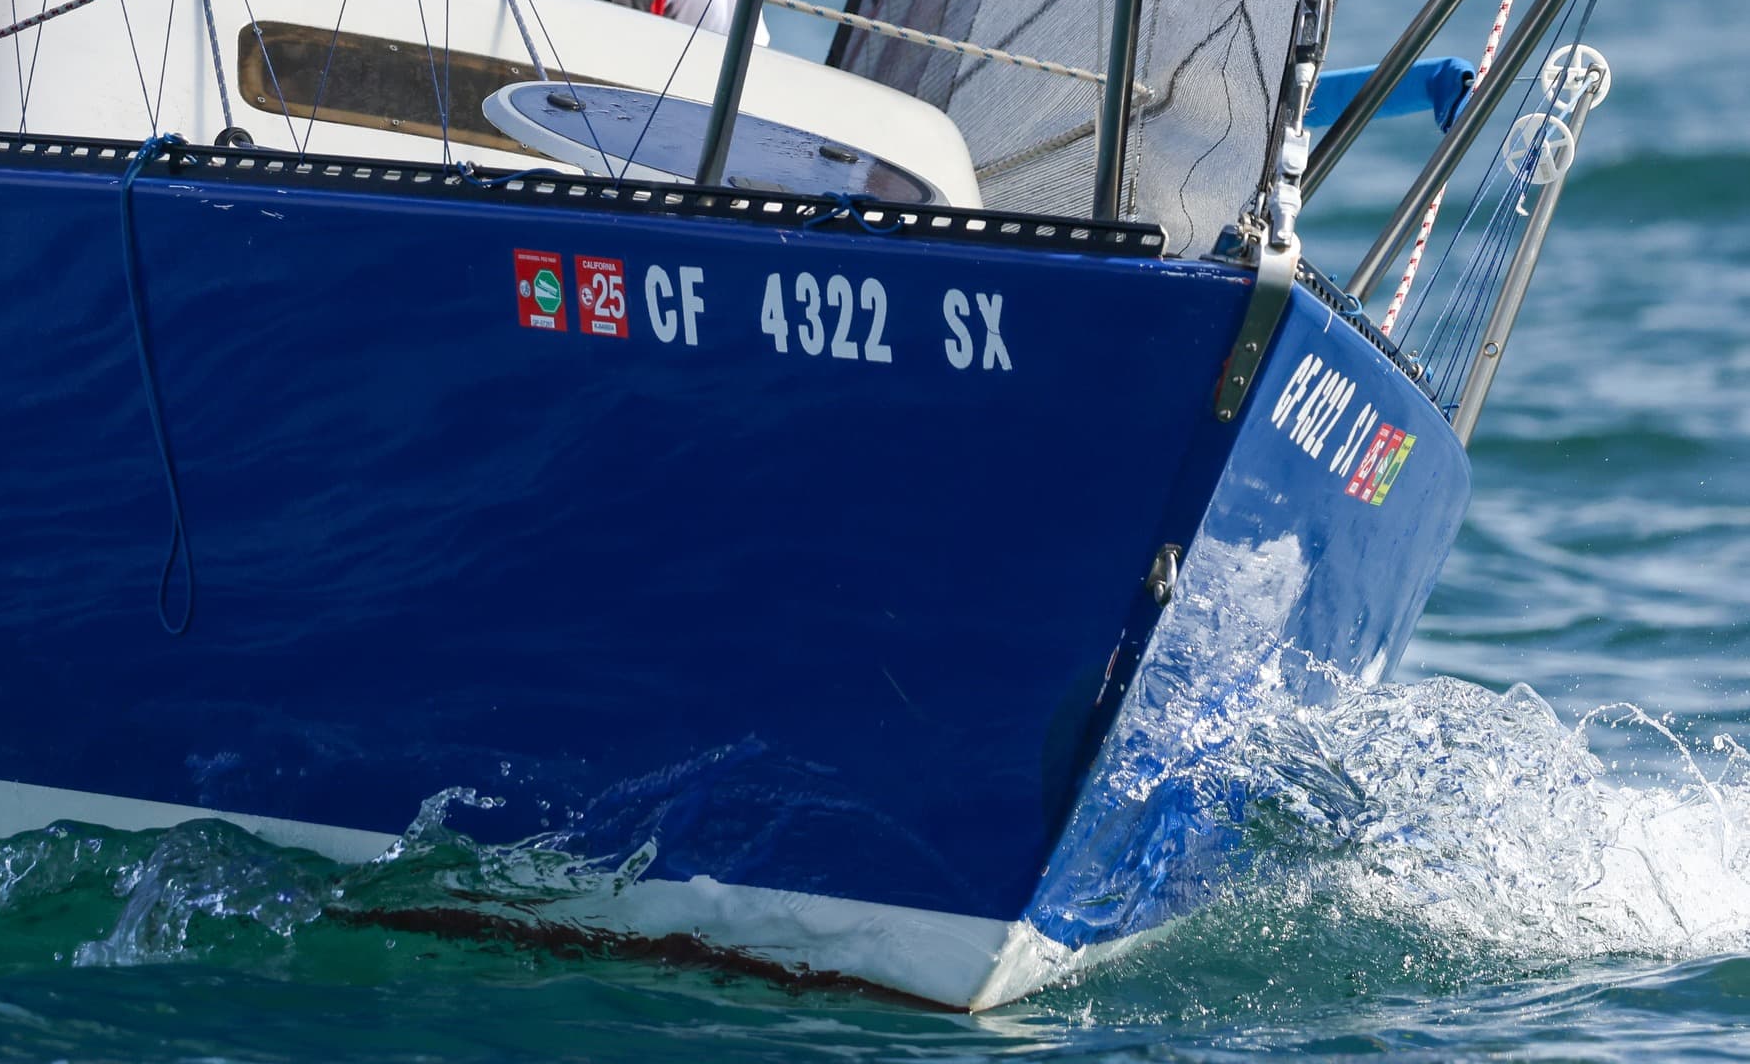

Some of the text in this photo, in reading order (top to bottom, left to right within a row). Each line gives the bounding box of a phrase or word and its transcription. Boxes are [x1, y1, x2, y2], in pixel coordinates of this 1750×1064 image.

[582, 260, 617, 271] CALIFORNIA
[592, 273, 625, 319] 25
[644, 265, 1013, 371] CF 4322 SX
[1271, 353, 1379, 478] CF 4322 SX
